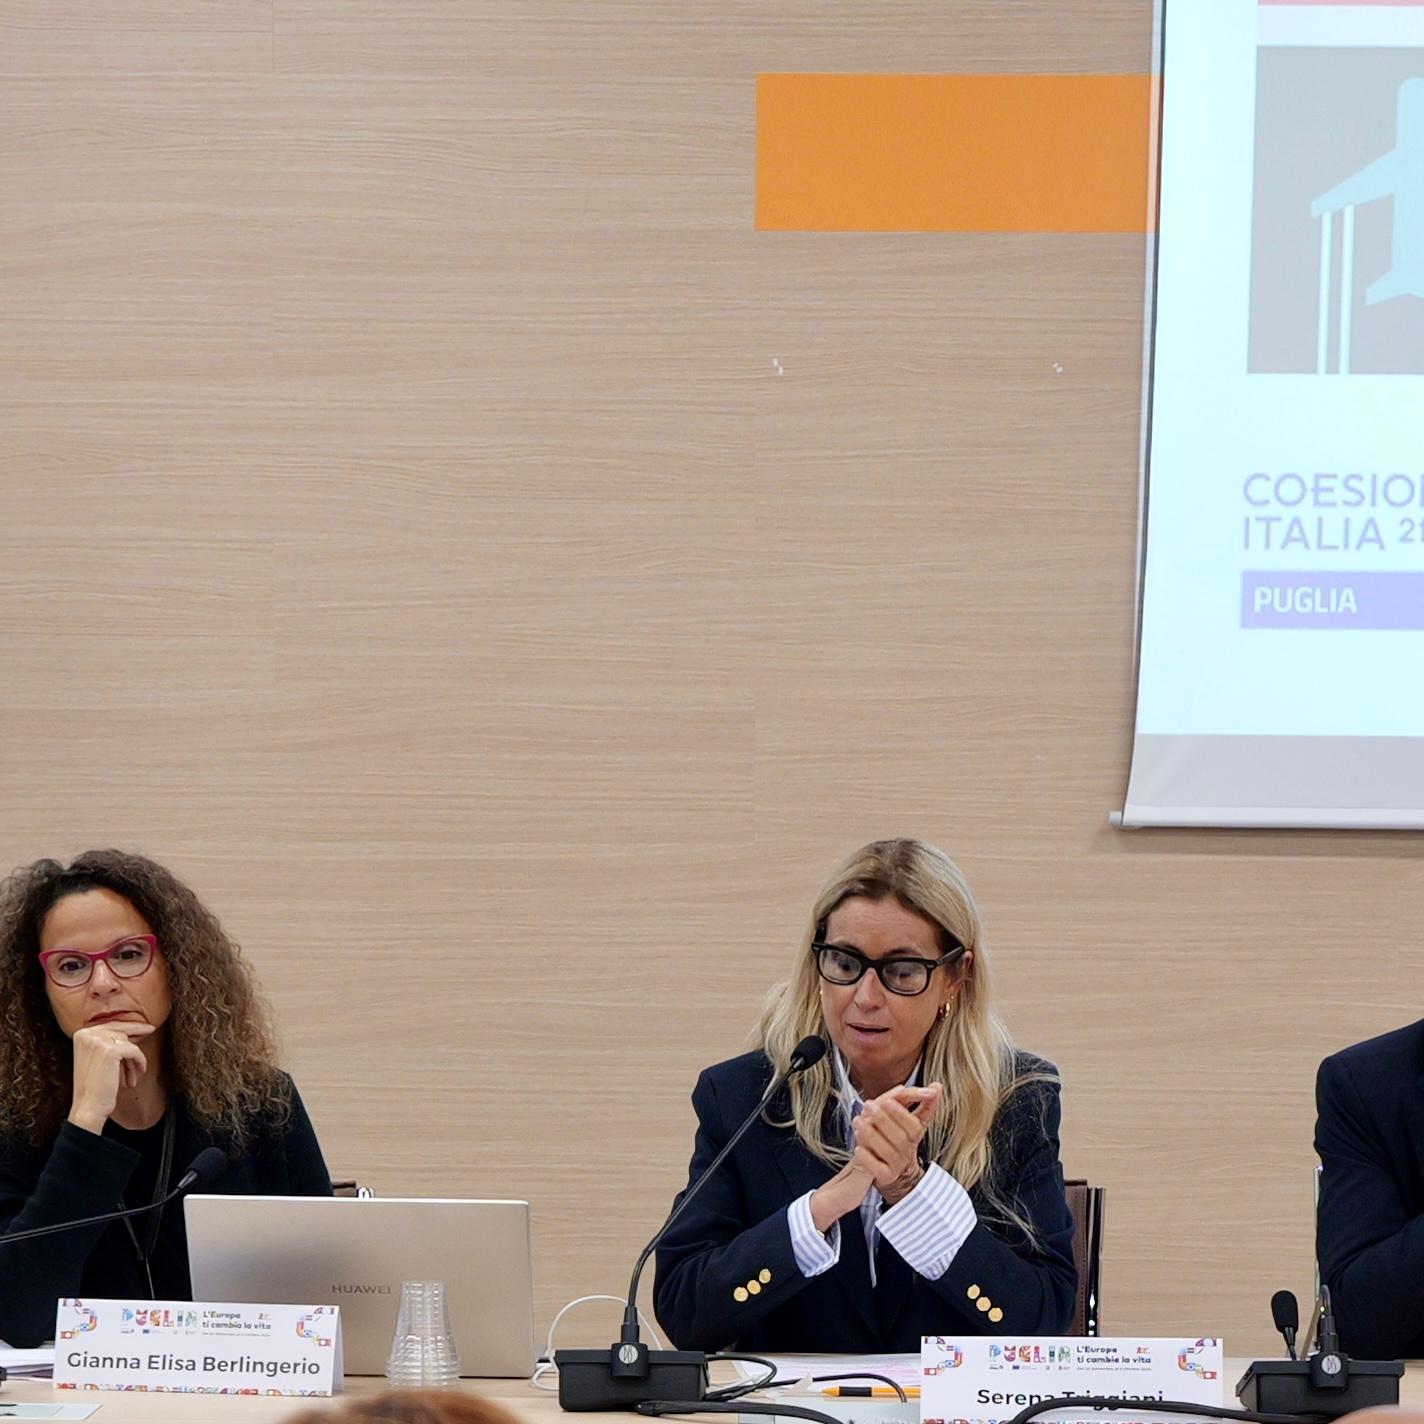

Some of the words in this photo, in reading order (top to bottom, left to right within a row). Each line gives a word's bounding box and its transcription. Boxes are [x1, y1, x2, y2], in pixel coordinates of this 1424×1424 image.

[1243, 515, 1385, 552] ITALIA
[1253, 586, 1358, 614] PUGLIA
[331, 1284, 392, 1295] HUAWEI
[67, 1350, 141, 1371] Gianna
[147, 1353, 197, 1372] Elisa
[202, 1354, 321, 1378] Berlingerio
